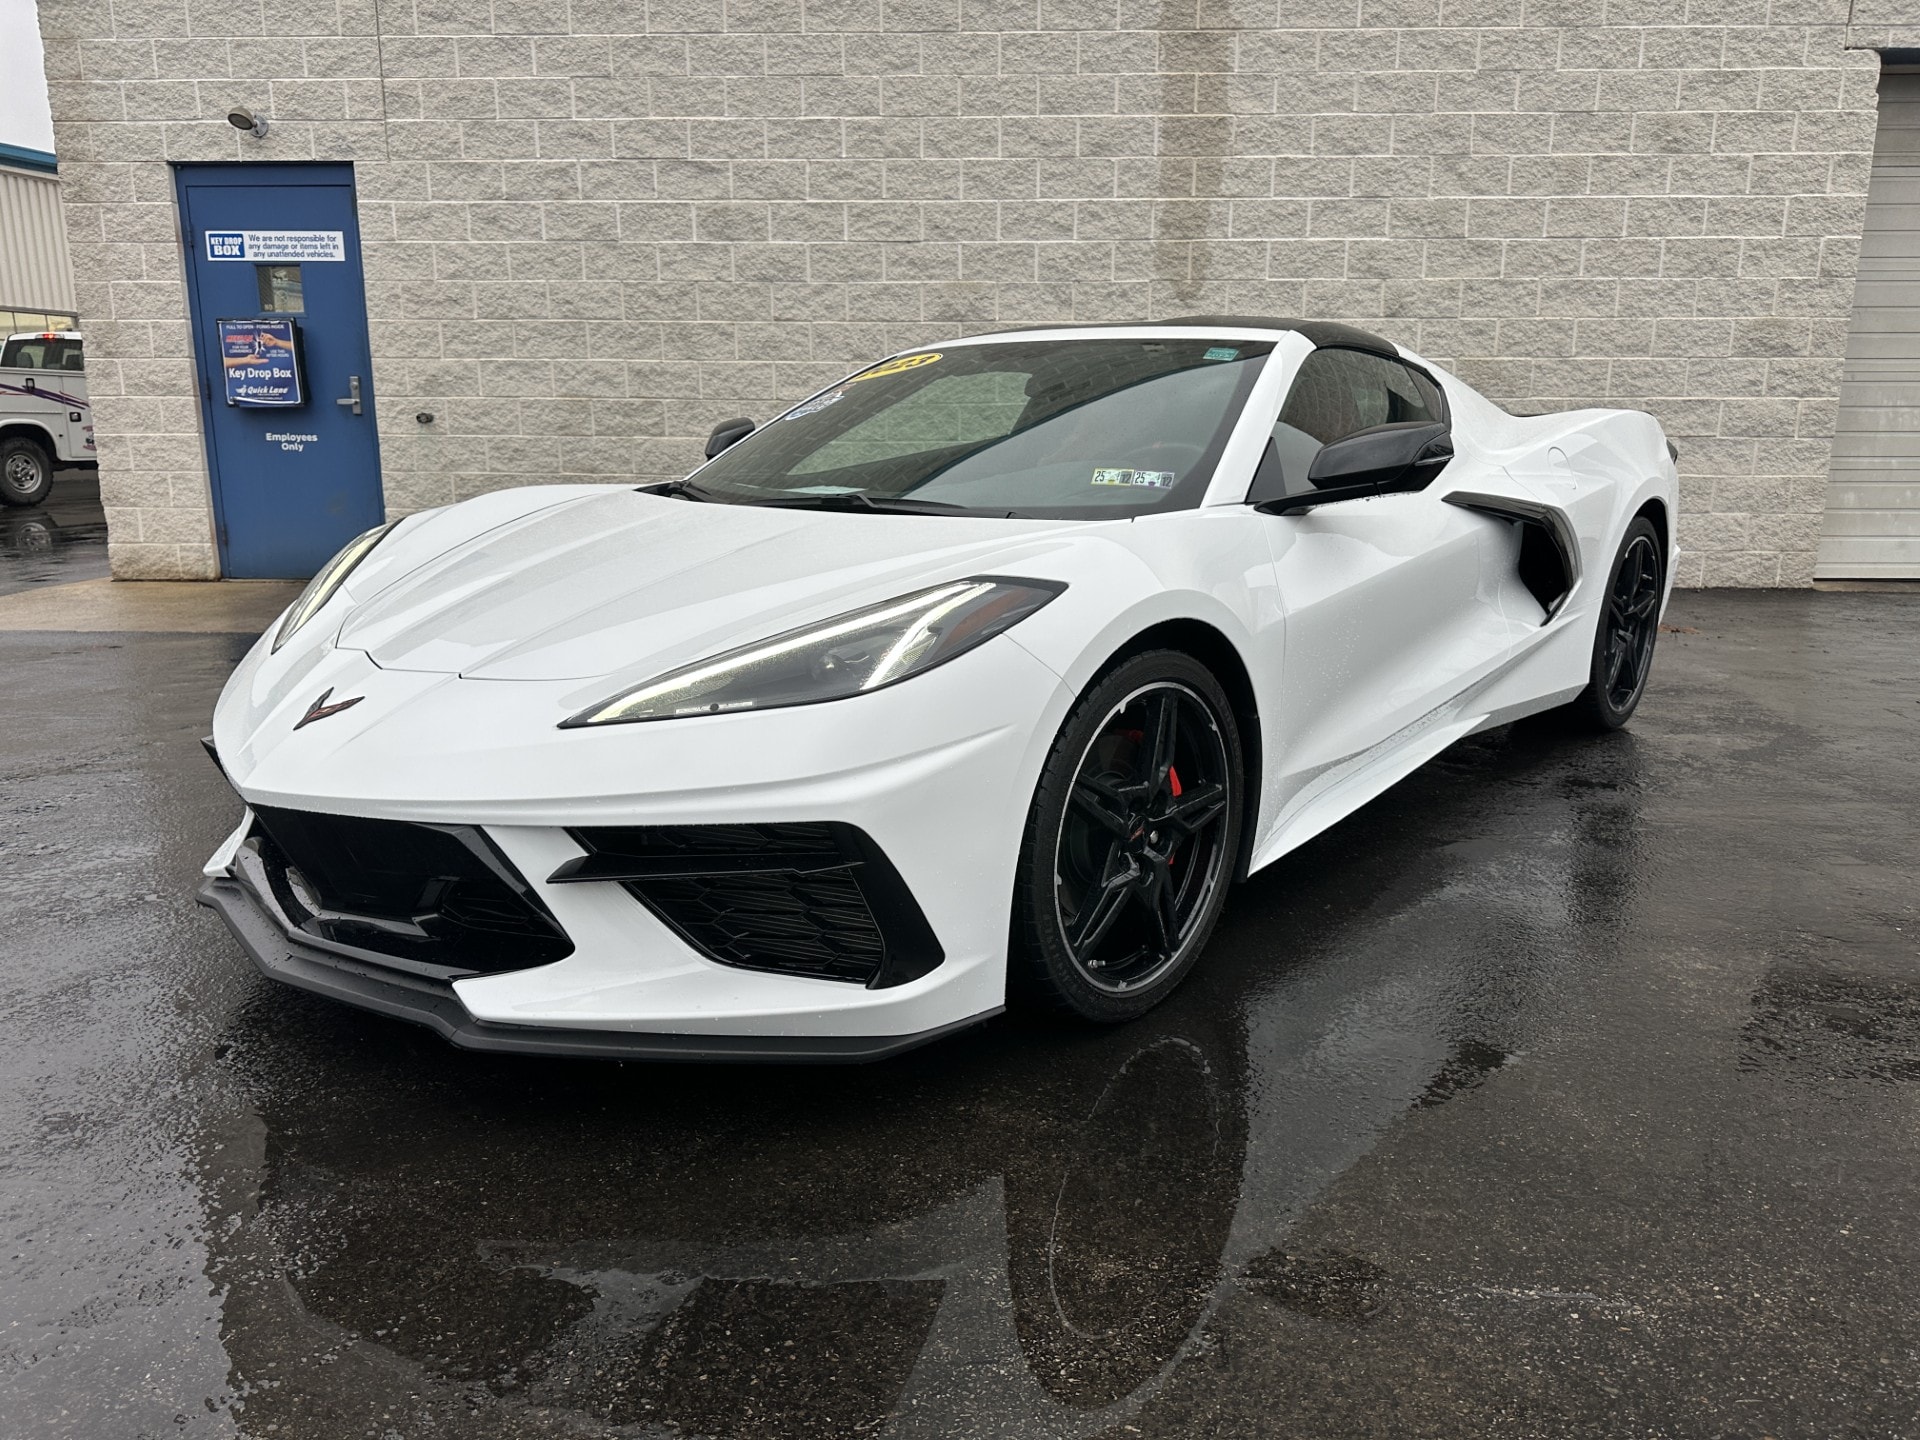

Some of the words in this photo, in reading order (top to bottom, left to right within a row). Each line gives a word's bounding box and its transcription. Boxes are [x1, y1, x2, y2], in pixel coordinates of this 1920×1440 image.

[248, 234, 261, 242] We
[274, 234, 285, 242] not
[286, 234, 325, 243] responsible
[327, 234, 336, 242] for
[214, 245, 240, 255] BOX
[248, 243, 261, 251] any
[262, 242, 289, 251] damage
[300, 242, 318, 250] items
[320, 242, 331, 250] left
[332, 242, 339, 250] in
[253, 251, 265, 259] any
[267, 250, 305, 258] unattended
[306, 250, 336, 258] vehicles.
[229, 368, 245, 380] Key
[247, 368, 271, 380] Drop
[273, 368, 292, 377] Box
[247, 386, 269, 394] Quick
[269, 386, 288, 394] Lane
[266, 433, 318, 442] Employees
[281, 442, 304, 452] Only
[1095, 471, 1106, 481] 25
[1120, 474, 1131, 483] 12
[1135, 472, 1145, 483] 25
[1162, 477, 1172, 486] 12
